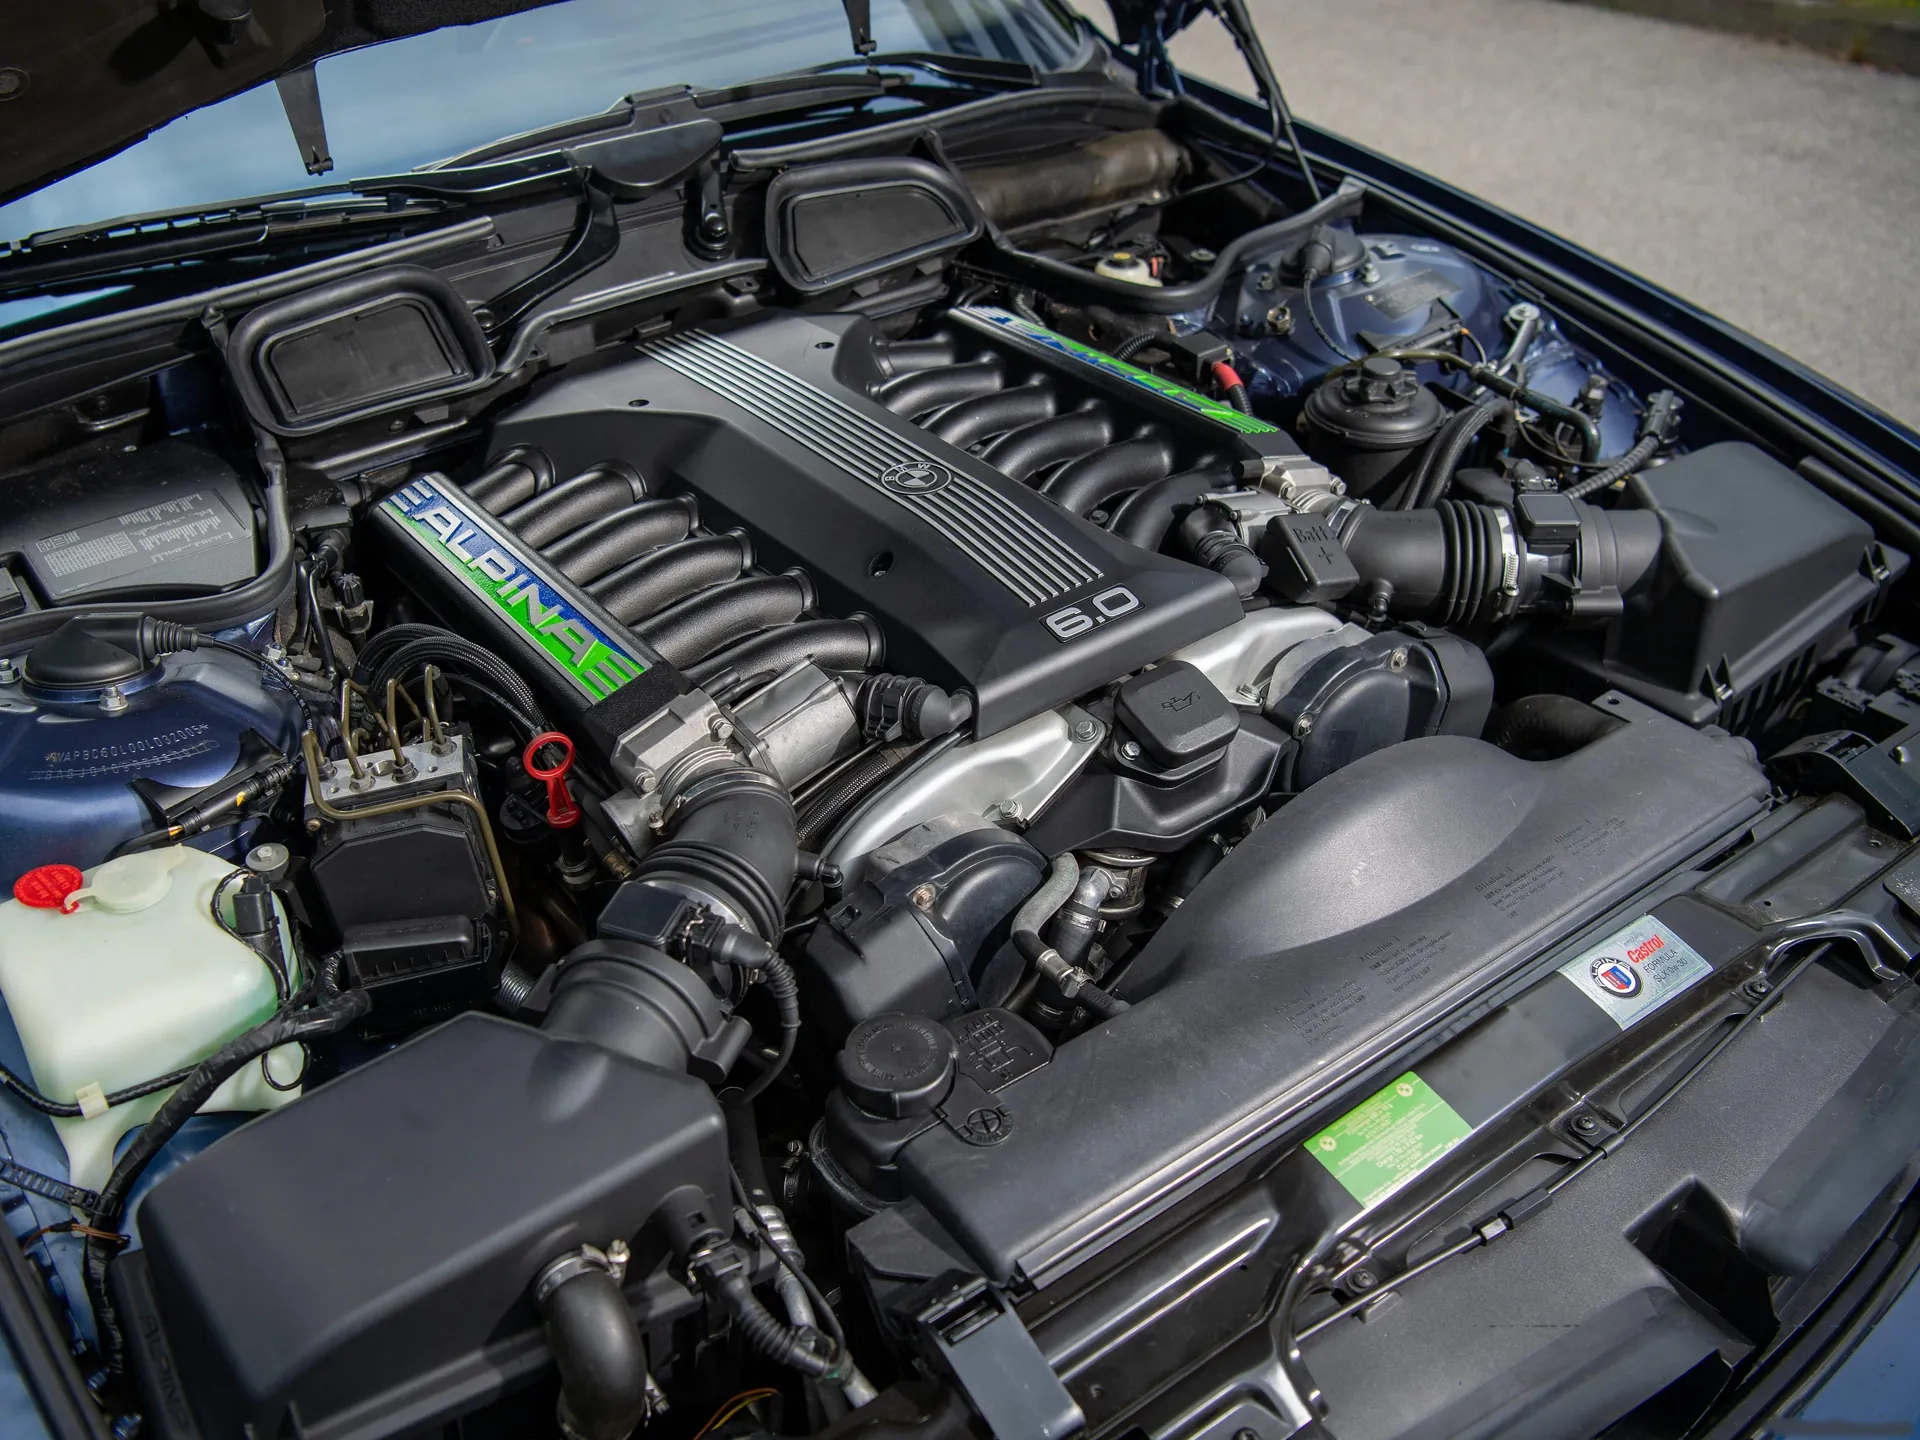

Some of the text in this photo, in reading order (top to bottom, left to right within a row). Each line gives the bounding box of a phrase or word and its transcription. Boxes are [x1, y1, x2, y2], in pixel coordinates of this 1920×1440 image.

[885, 463, 931, 482] BMW
[1293, 526, 1336, 543] Batt.
[412, 505, 600, 670] ALPINA
[1046, 587, 1139, 638] 6.0
[1627, 933, 1665, 964] Castrol
[1643, 948, 1679, 974] FORMULA
[1653, 968, 1671, 983] SLX
[963, 1012, 992, 1034] KALT
